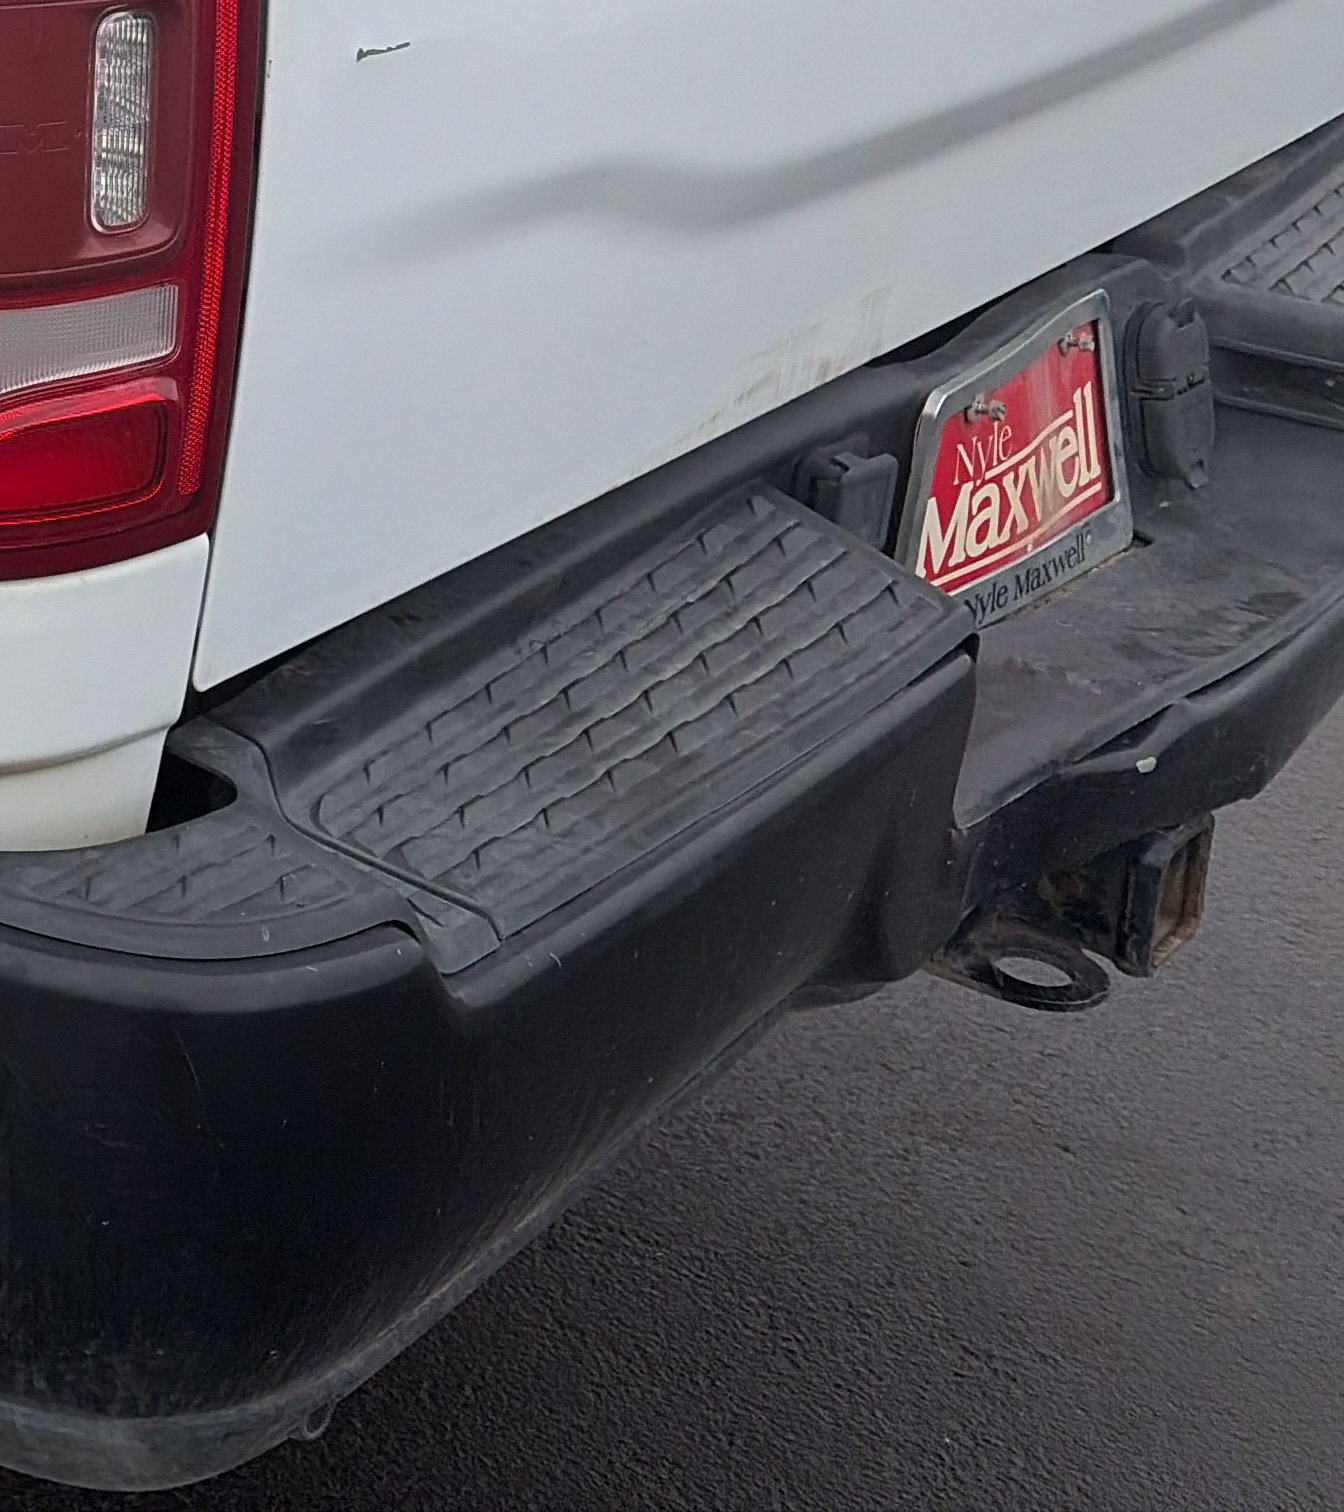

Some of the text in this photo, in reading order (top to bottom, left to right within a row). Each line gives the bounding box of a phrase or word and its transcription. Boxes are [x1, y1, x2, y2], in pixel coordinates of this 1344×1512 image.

[915, 381, 1102, 579] Maxwell
[953, 420, 1013, 486] Nyle
[1013, 532, 1086, 601] Maxwell
